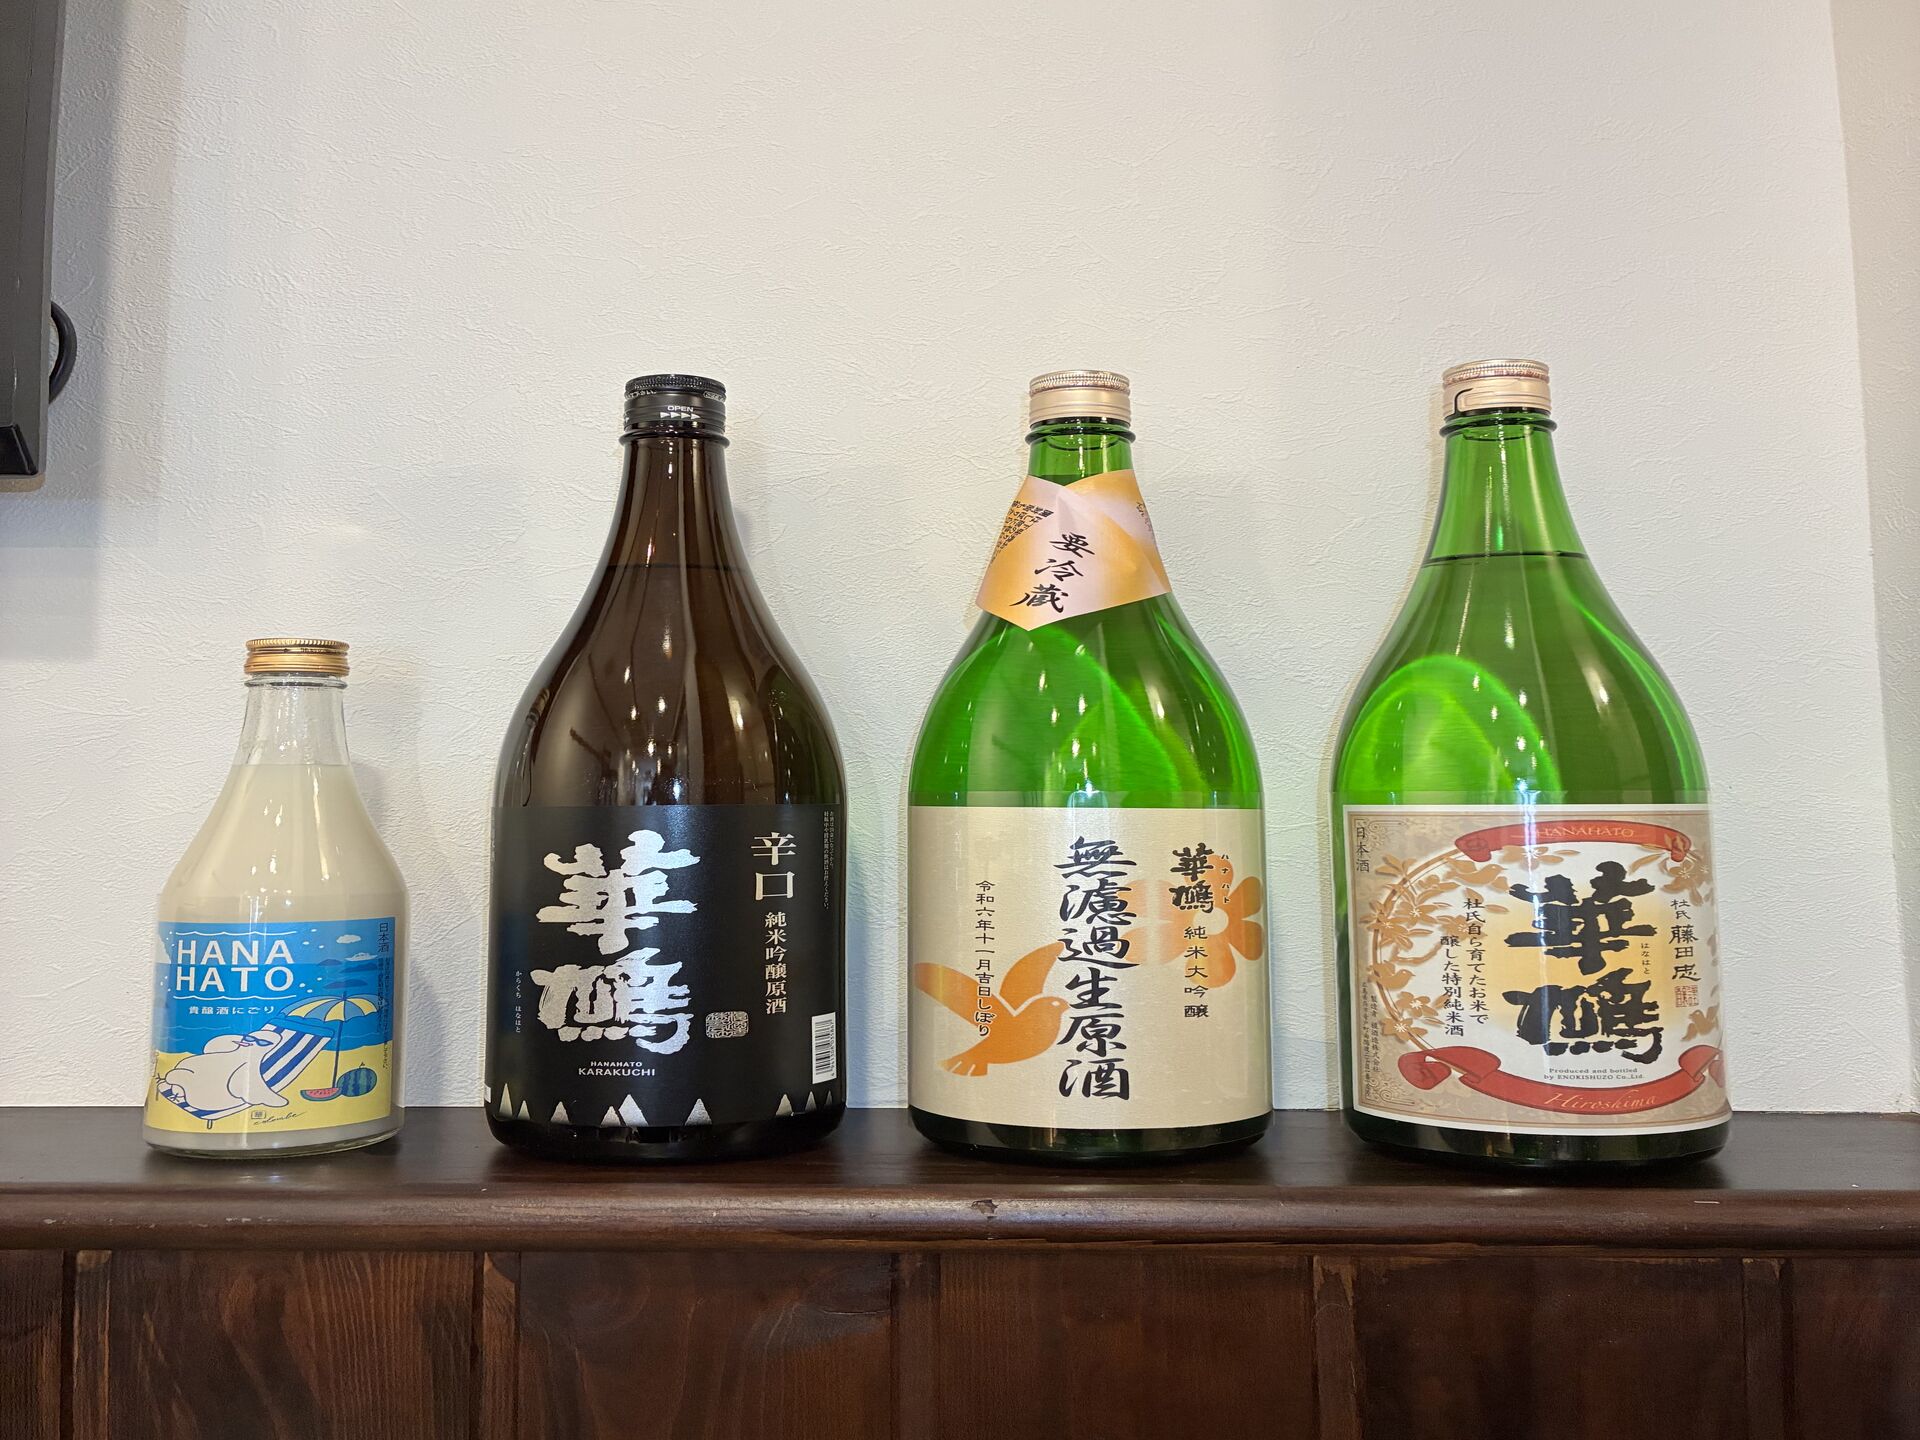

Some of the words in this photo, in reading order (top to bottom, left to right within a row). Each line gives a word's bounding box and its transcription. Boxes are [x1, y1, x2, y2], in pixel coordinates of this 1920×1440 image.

[1009, 532, 1095, 614] 要冷蔵
[1355, 826, 1370, 873] 日本酒
[1537, 826, 1634, 838] HANAHATO
[751, 832, 797, 901] 辛口
[1221, 854, 1230, 904] ハナハト
[177, 939, 295, 965] HANA
[378, 922, 390, 953] 日本酒
[975, 880, 995, 1037] 令和六年十一月吉日しぼり
[1463, 898, 1489, 1025] 杜氏自ら育てたお米で
[1640, 942, 1651, 975] はなはと
[175, 966, 294, 992] HATO
[764, 911, 787, 1015] 純米吟醸原酒
[1053, 836, 1140, 1100] 無濾過生原酒
[1184, 925, 1209, 1019] 純米大吟醸
[1440, 934, 1465, 1037] 醸した特別純米酒
[578, 1067, 656, 1077] KARAKUCHI
[1544, 1089, 1656, 1110] Hiroshima
